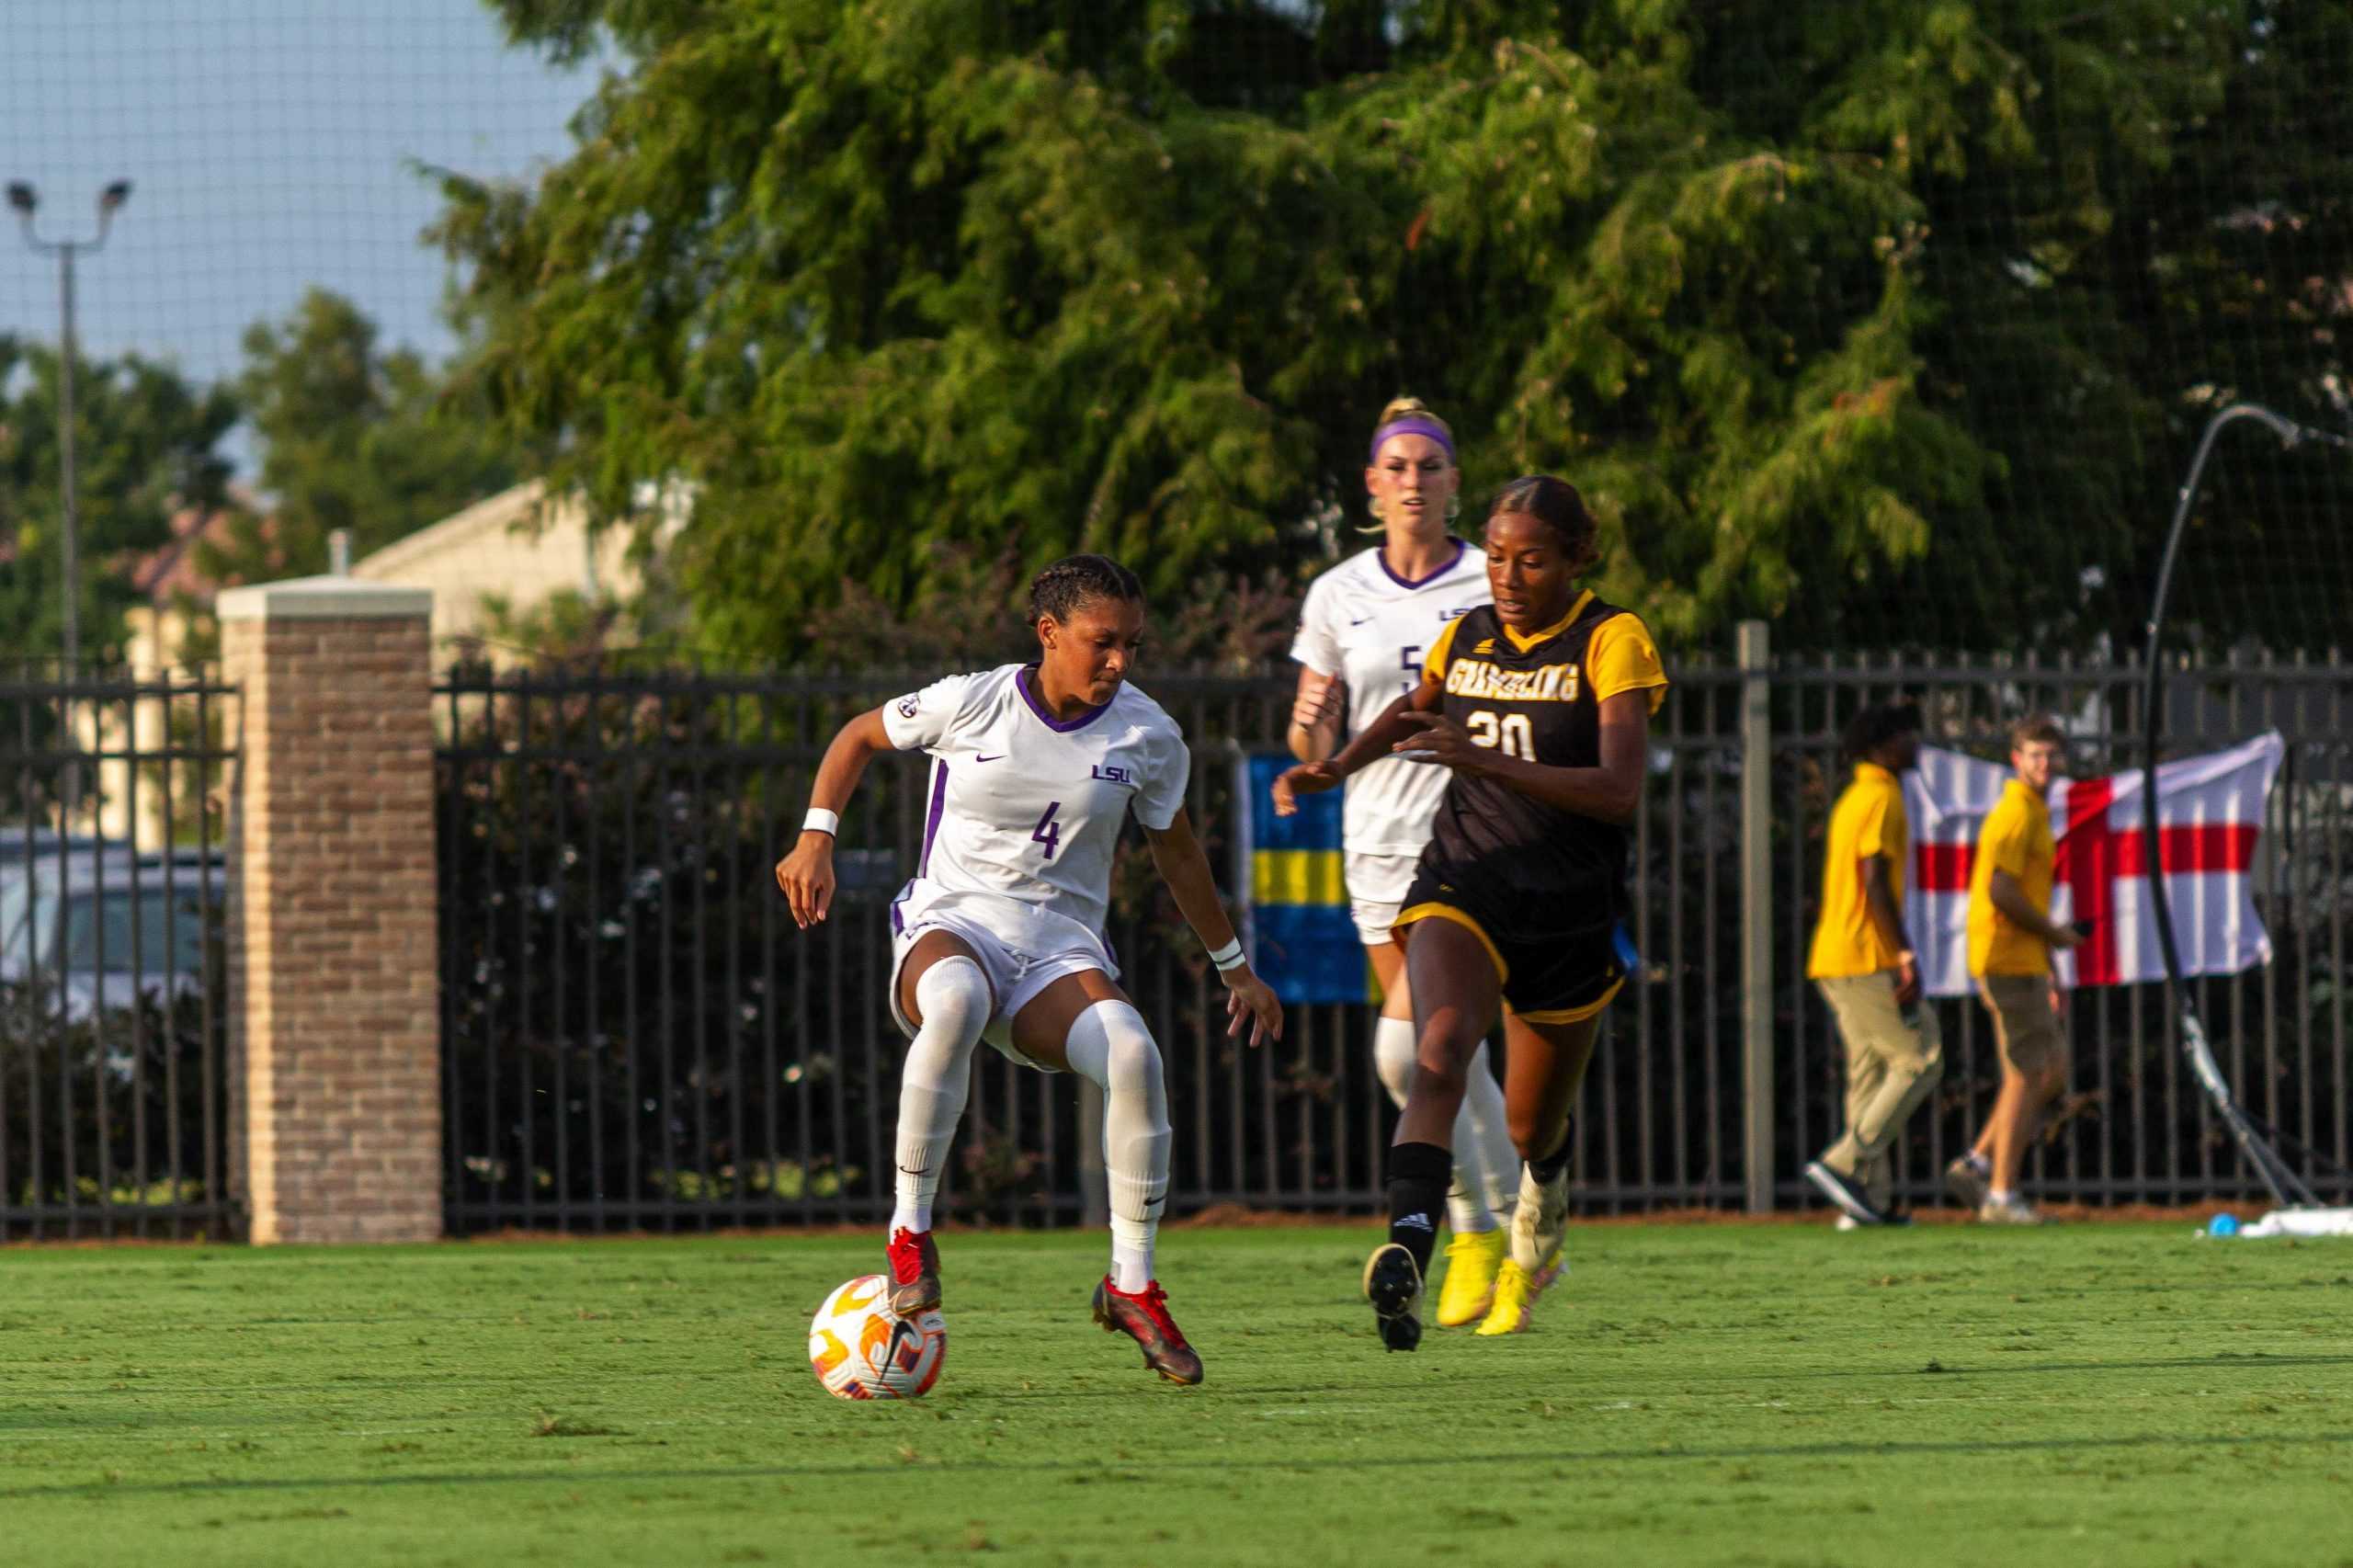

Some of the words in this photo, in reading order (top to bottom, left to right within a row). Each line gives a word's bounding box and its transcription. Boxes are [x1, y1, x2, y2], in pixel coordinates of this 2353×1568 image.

[1438, 608, 1472, 621] LS
[1401, 646, 1423, 692] 5
[1466, 710, 1537, 762] 20
[1092, 765, 1131, 783] LSU
[1031, 801, 1060, 859] 4
